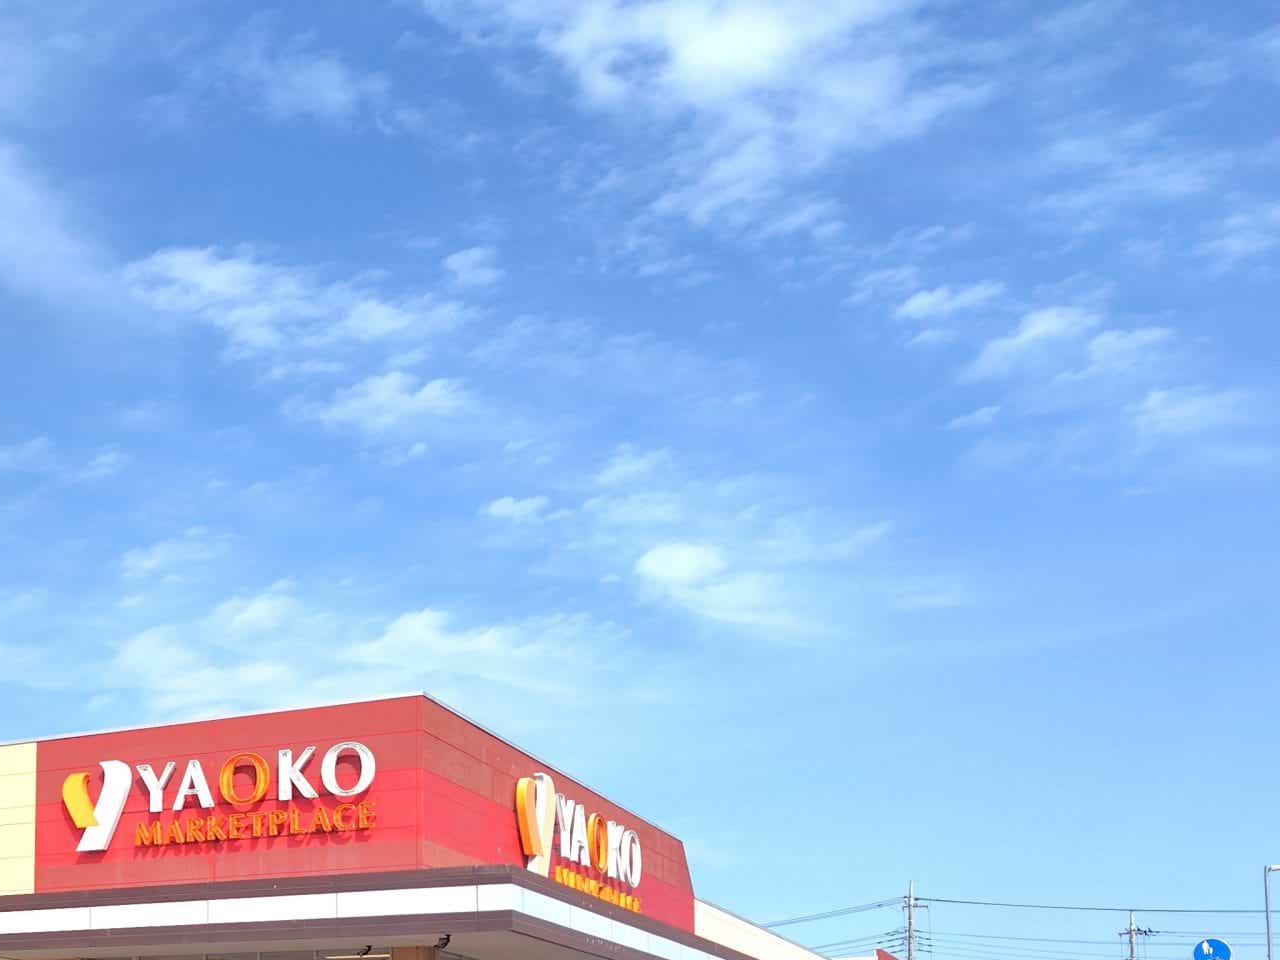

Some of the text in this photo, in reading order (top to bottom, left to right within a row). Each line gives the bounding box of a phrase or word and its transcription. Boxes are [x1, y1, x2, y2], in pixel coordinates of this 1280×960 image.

[136, 741, 376, 812] YAOKO
[134, 801, 376, 847] MARKETPLACE
[555, 793, 642, 888] YAOKO
